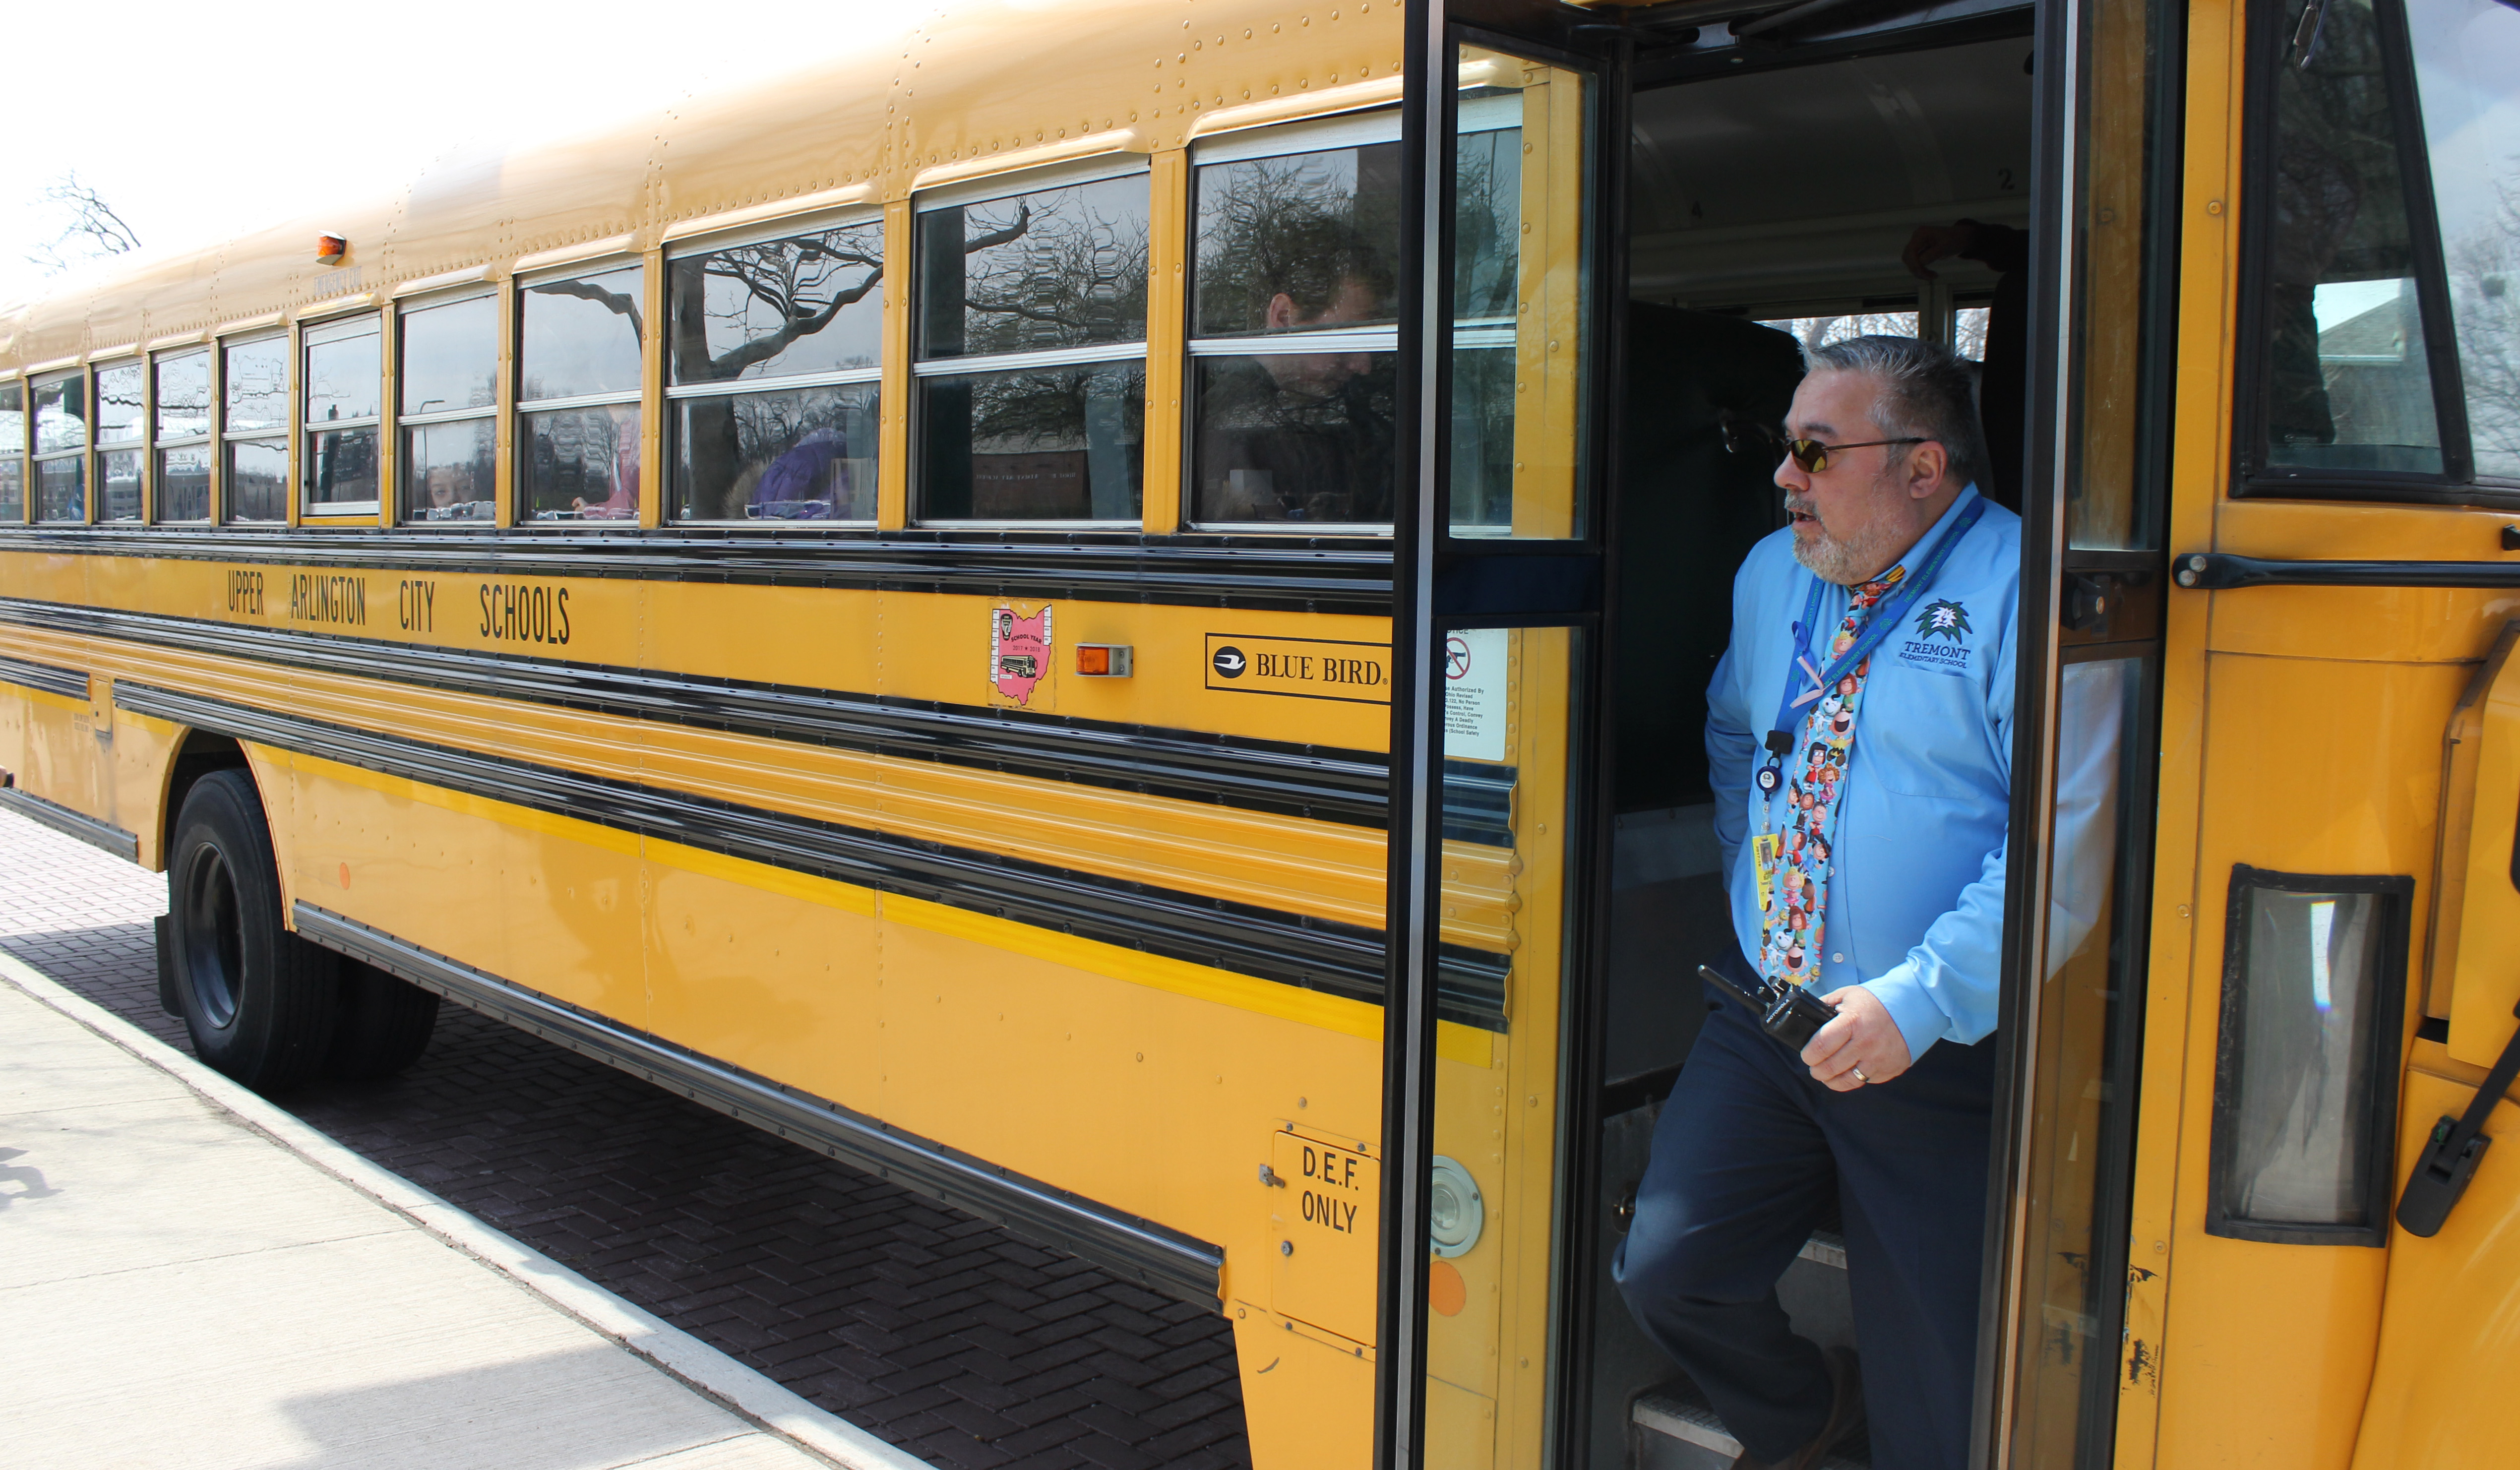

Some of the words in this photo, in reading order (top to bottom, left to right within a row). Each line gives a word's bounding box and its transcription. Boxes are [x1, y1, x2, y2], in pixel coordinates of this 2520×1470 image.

[1997, 168, 2015, 191] 2
[314, 270, 347, 296] EMERGENCY
[350, 265, 362, 288] EXIT
[1904, 580, 1923, 603] TREMONT
[1921, 549, 1945, 581] ELEMENTARY
[1944, 531, 1960, 549] SCHOOL
[228, 570, 264, 615] UPPER
[291, 574, 366, 626] ARLINGTON
[400, 580, 435, 632] CITY
[480, 584, 570, 645] SCHOOLS
[1030, 635, 1042, 644] YEAR
[1905, 641, 1971, 661] TREMONT
[1256, 653, 1314, 680] BLUE
[1832, 651, 1860, 679] ELEMENTARY
[1859, 633, 1878, 652] SCHOOL
[1899, 652, 1939, 664] ELEMENTARY
[1939, 657, 1967, 669] SCHOOL
[1766, 998, 1790, 1024] MOTOROLA
[1303, 1146, 1359, 1191] D.E.F.
[1302, 1190, 1357, 1233] ONLY
